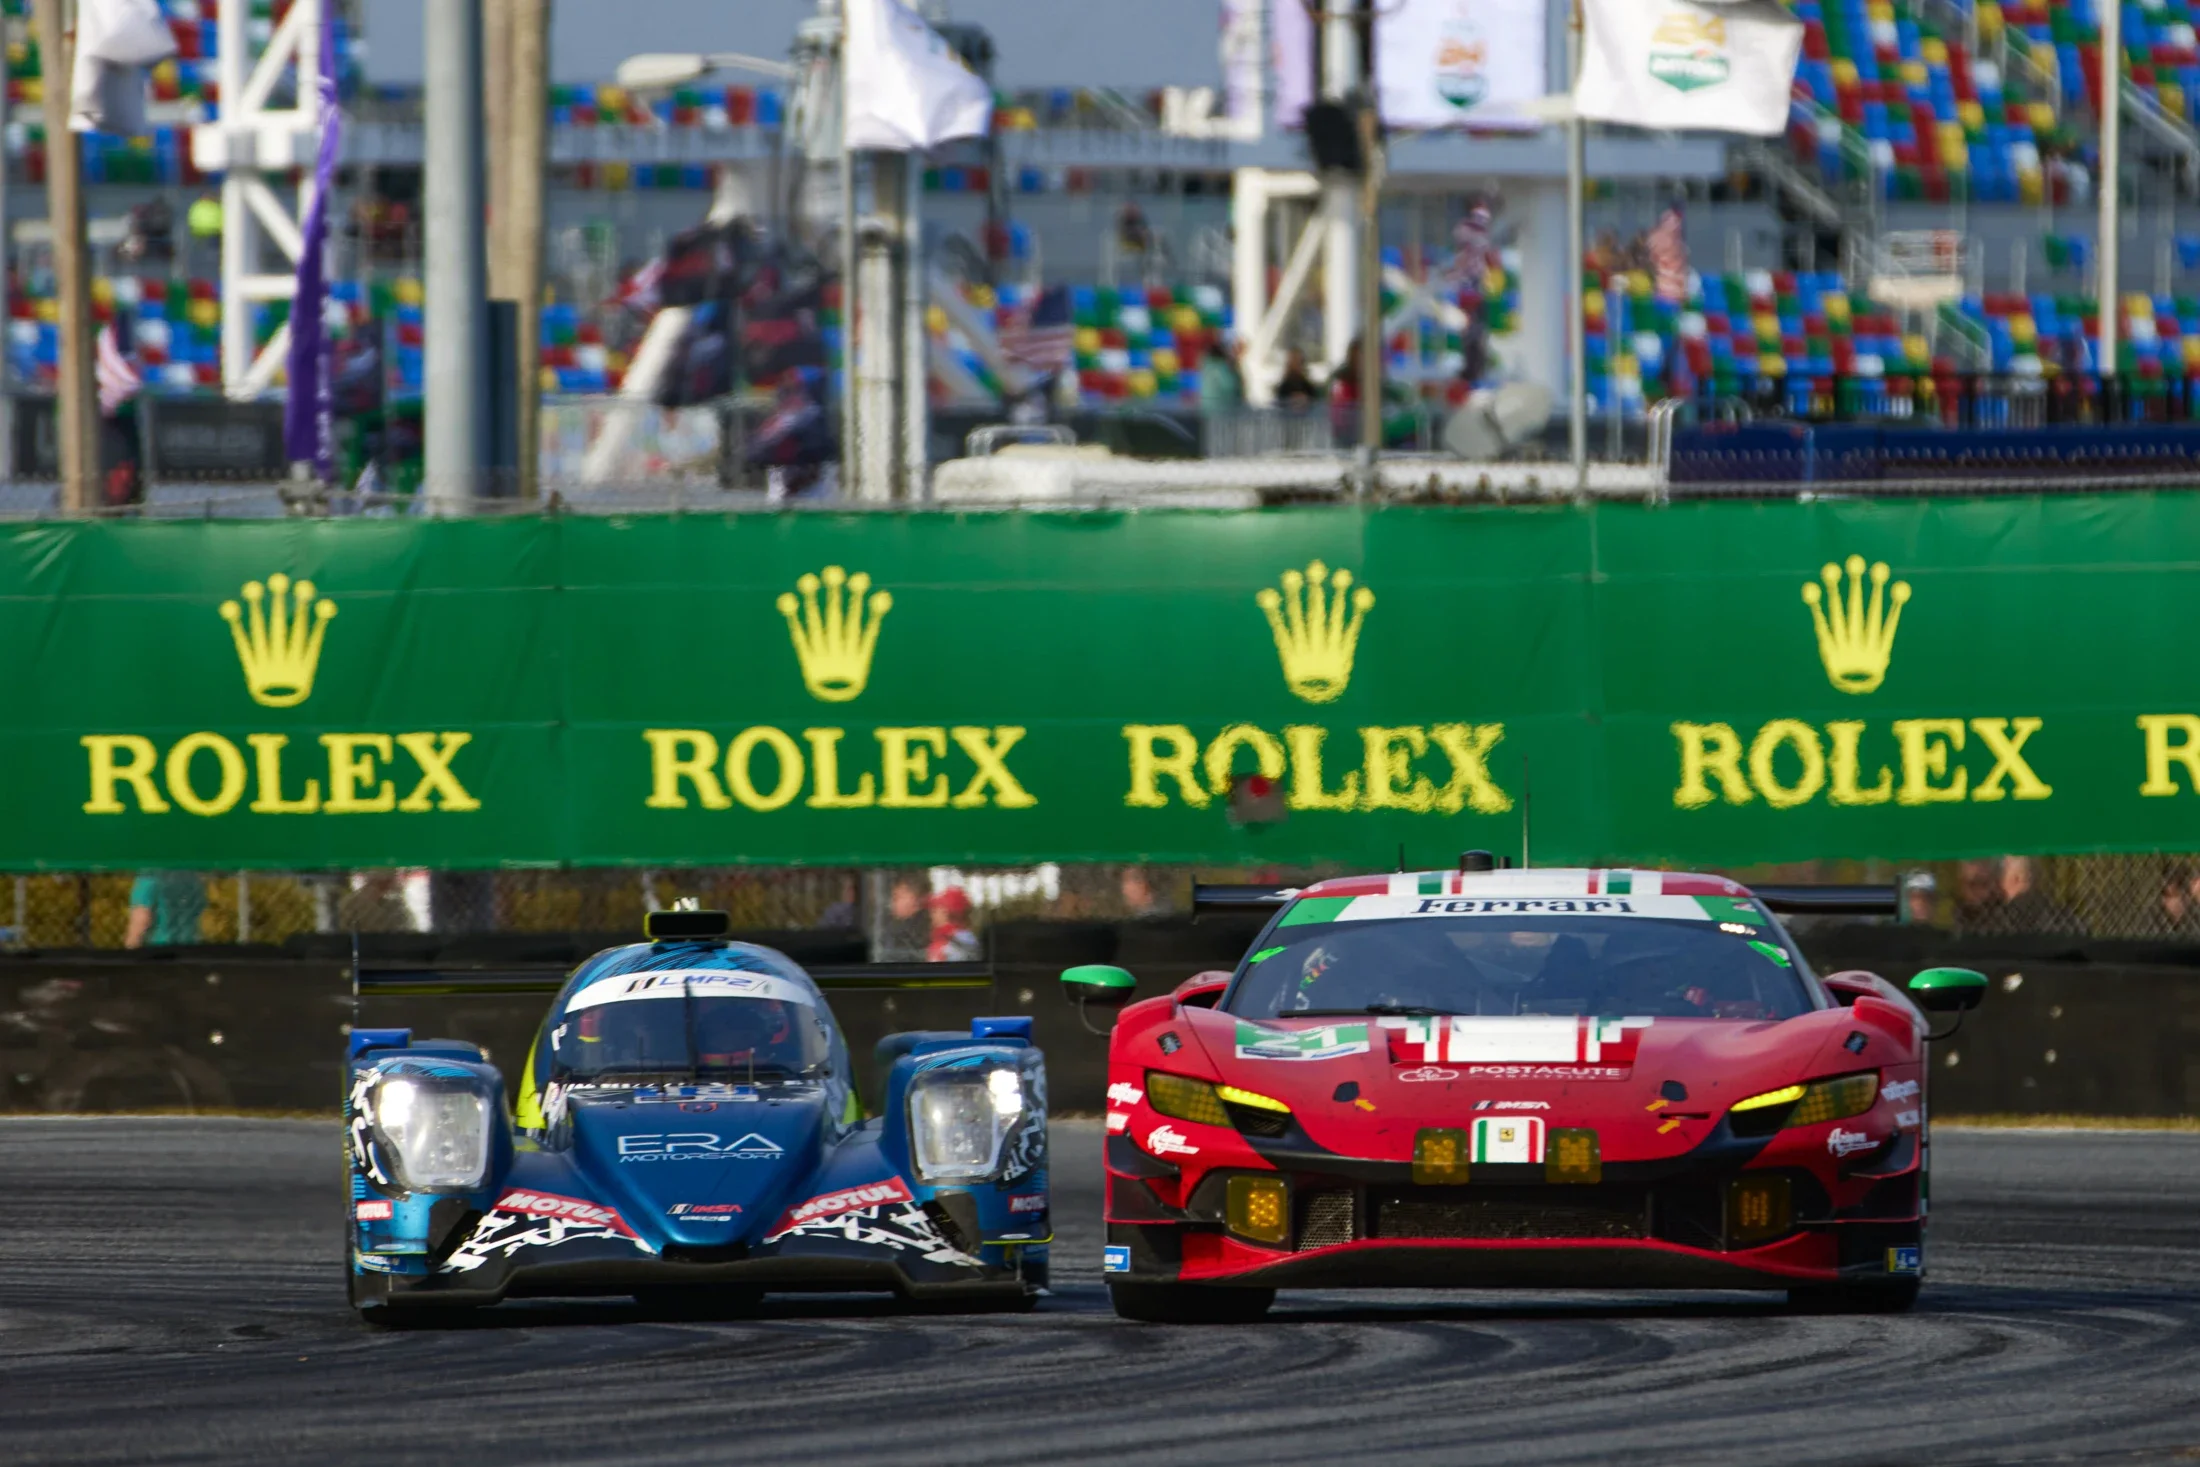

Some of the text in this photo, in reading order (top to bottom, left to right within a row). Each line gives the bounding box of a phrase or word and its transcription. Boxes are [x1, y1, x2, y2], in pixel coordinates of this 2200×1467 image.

[1672, 717, 2052, 808] ROLEX
[2136, 714, 2200, 797] R
[81, 732, 480, 816] ROLEX
[644, 725, 1036, 811] ROLEX
[1122, 722, 1515, 814] ROLEX
[1410, 897, 1637, 914] Ferrari
[659, 974, 753, 987] LMP2
[1253, 1027, 1339, 1050] 21
[1468, 1065, 1621, 1077] POSTACUTE
[1494, 1100, 1551, 1111] IMSA
[617, 1132, 785, 1155] ERA
[618, 1151, 786, 1164] MOTORSPORT
[501, 1191, 617, 1224] MOTUL
[691, 1203, 744, 1213] IMSA
[788, 1186, 901, 1220] MOTUL
